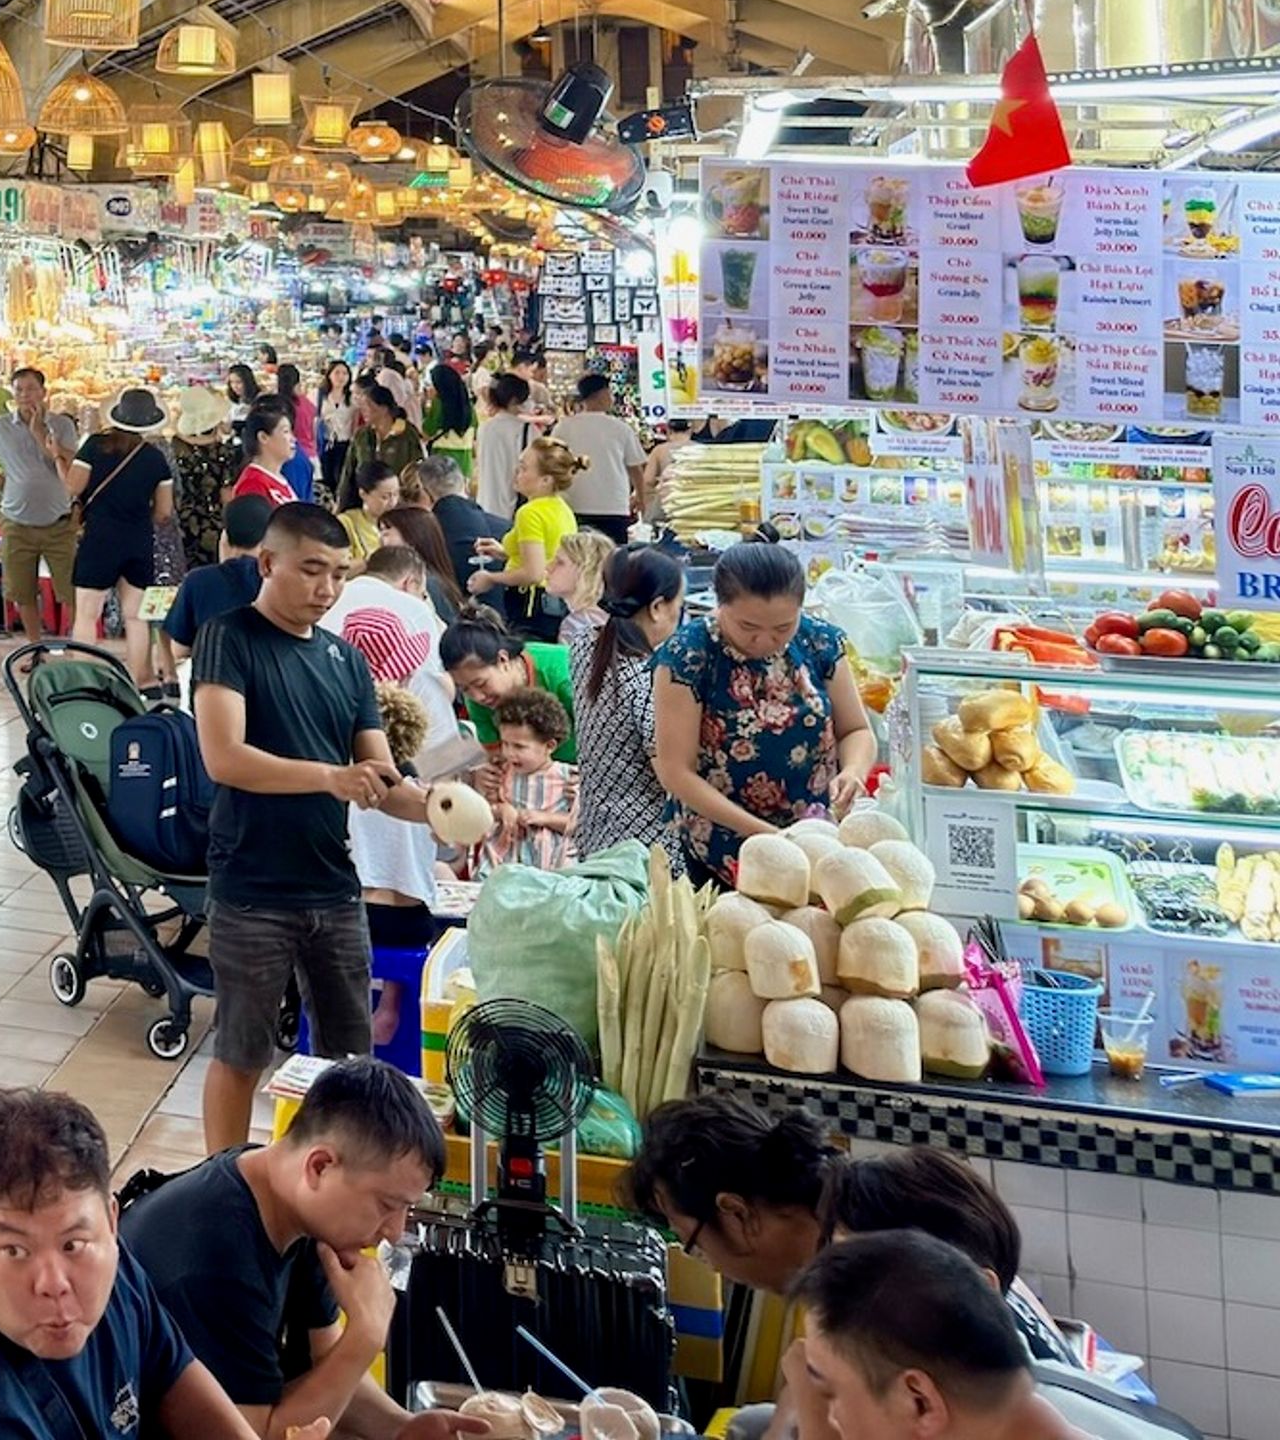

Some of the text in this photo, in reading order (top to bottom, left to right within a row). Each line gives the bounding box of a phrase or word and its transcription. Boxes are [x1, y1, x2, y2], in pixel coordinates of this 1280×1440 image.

[790, 230, 827, 241] 40.000
[1096, 242, 1138, 253] 30.000
[939, 313, 979, 325] 30.000
[1096, 321, 1138, 333] 30.000
[1096, 402, 1139, 414] 40.000
